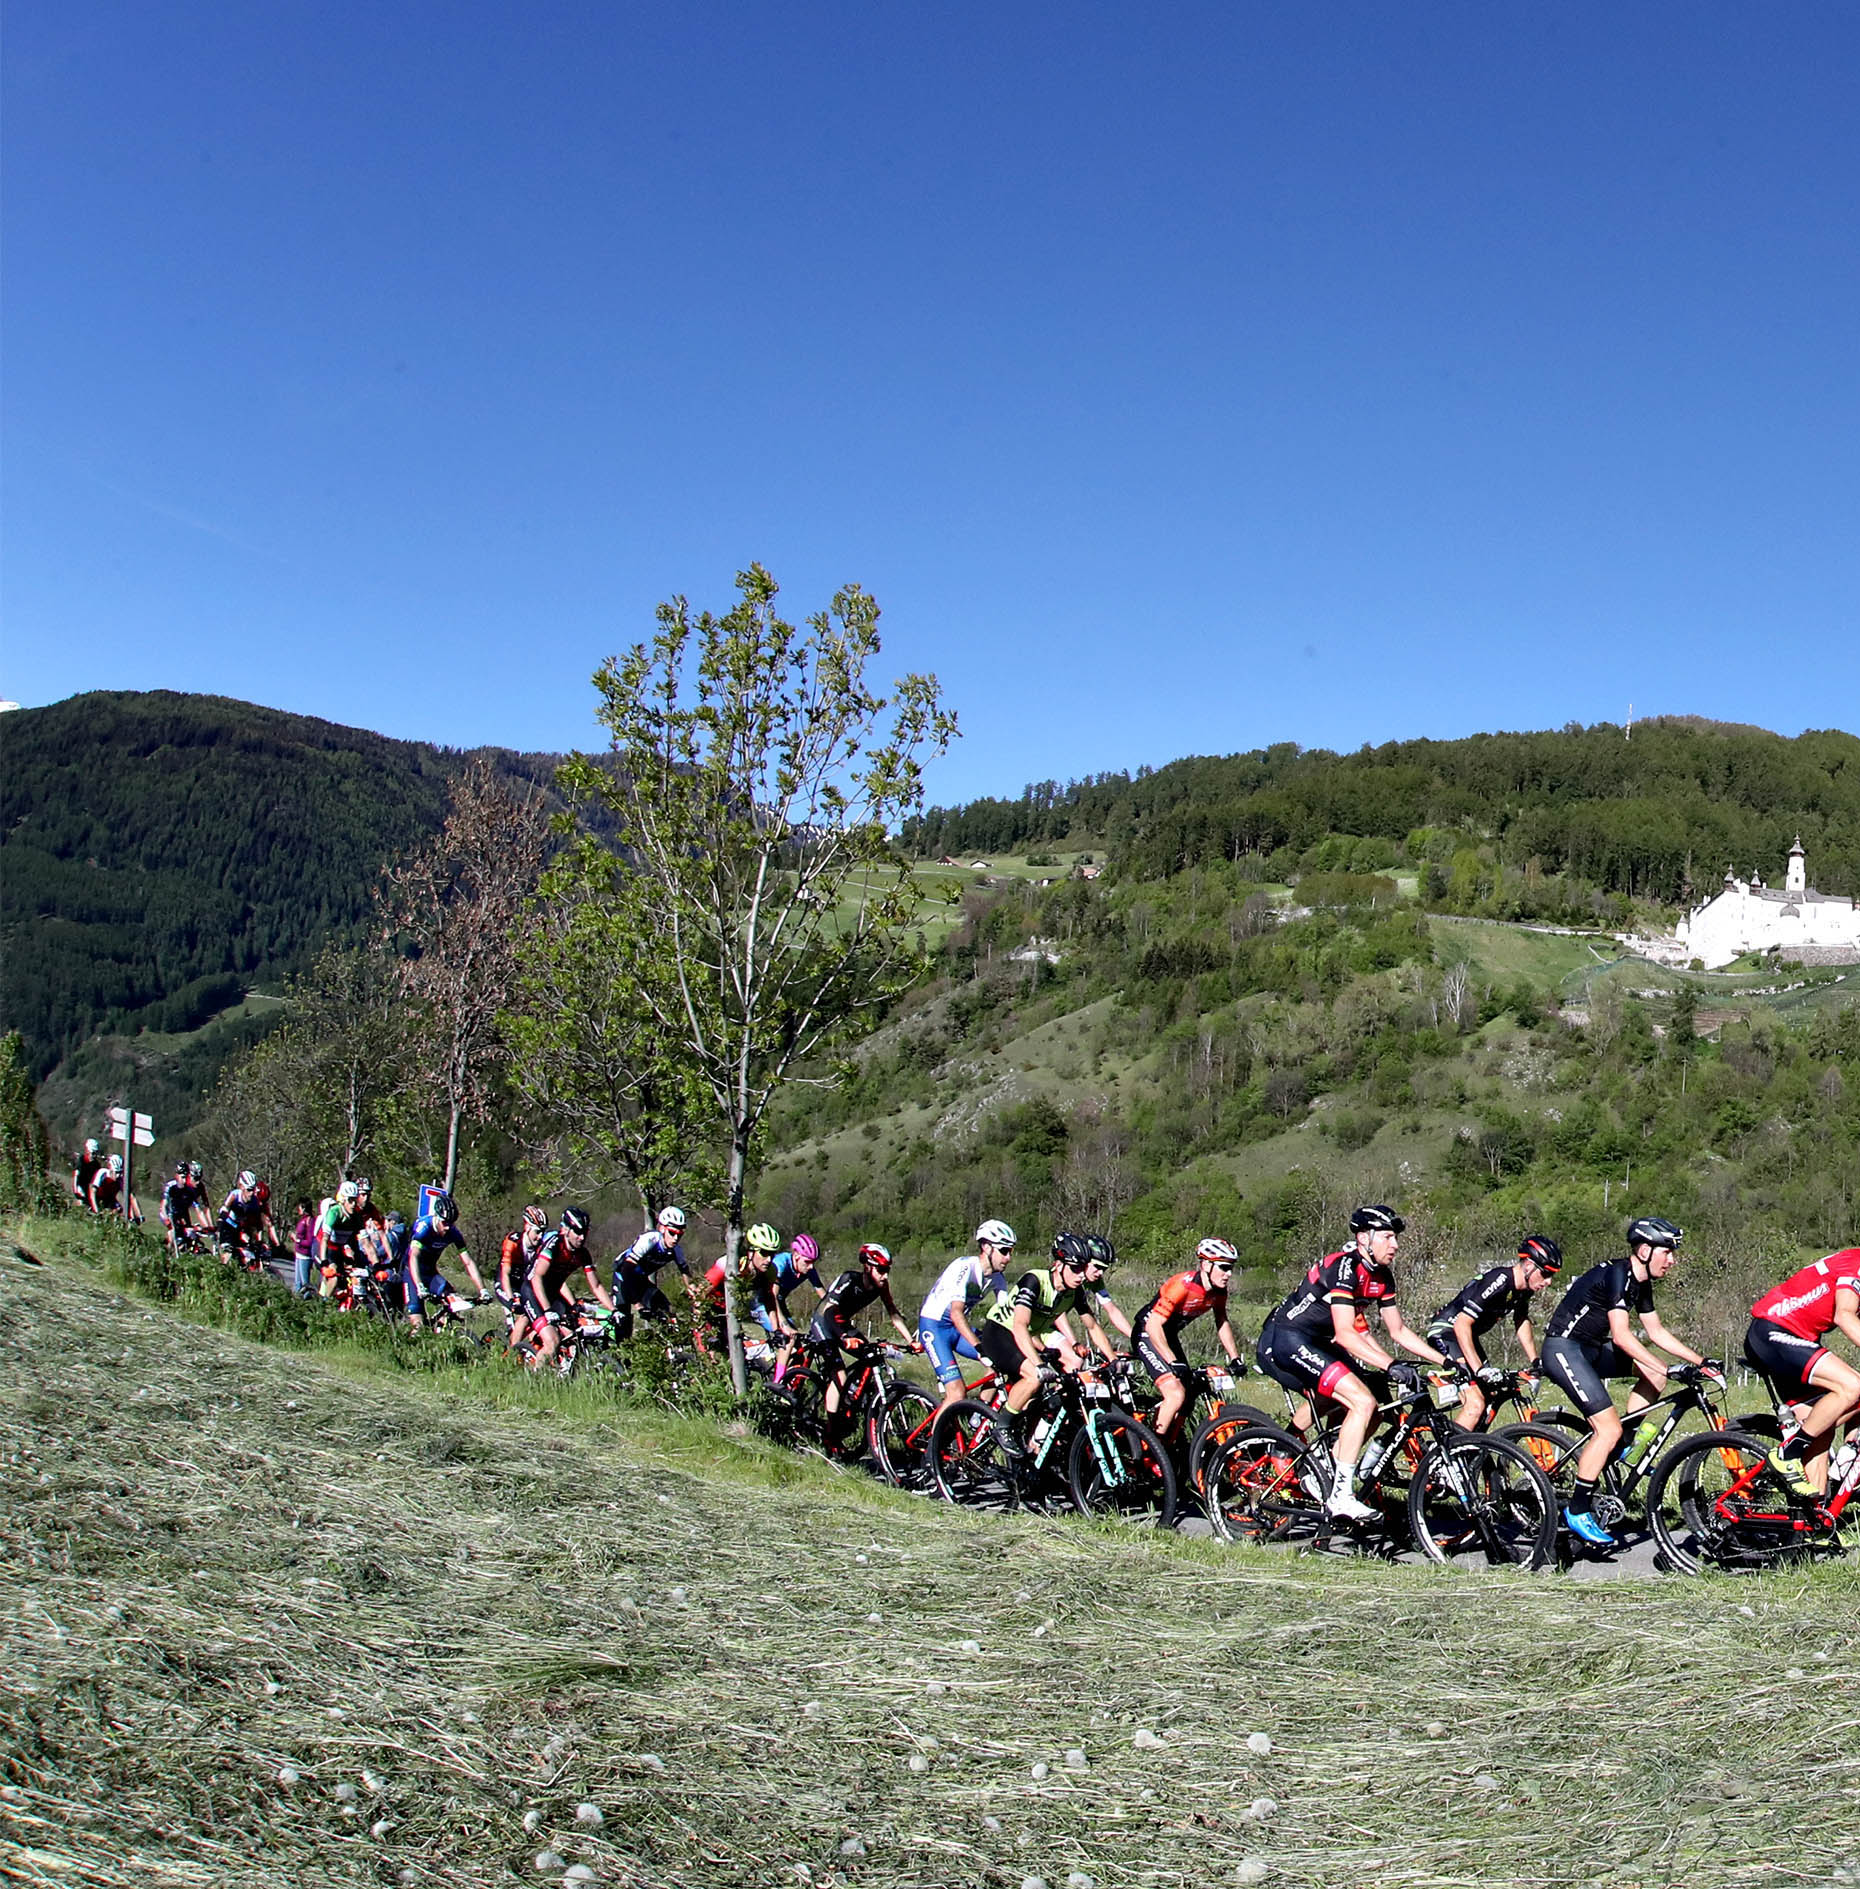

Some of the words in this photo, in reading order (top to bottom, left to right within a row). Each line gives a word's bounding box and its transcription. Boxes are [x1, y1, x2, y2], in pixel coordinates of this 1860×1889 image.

[1556, 1353, 1589, 1402] BULLS
[1372, 1423, 1409, 1478] SIMPLON
[1637, 1417, 1675, 1475] BULLS
